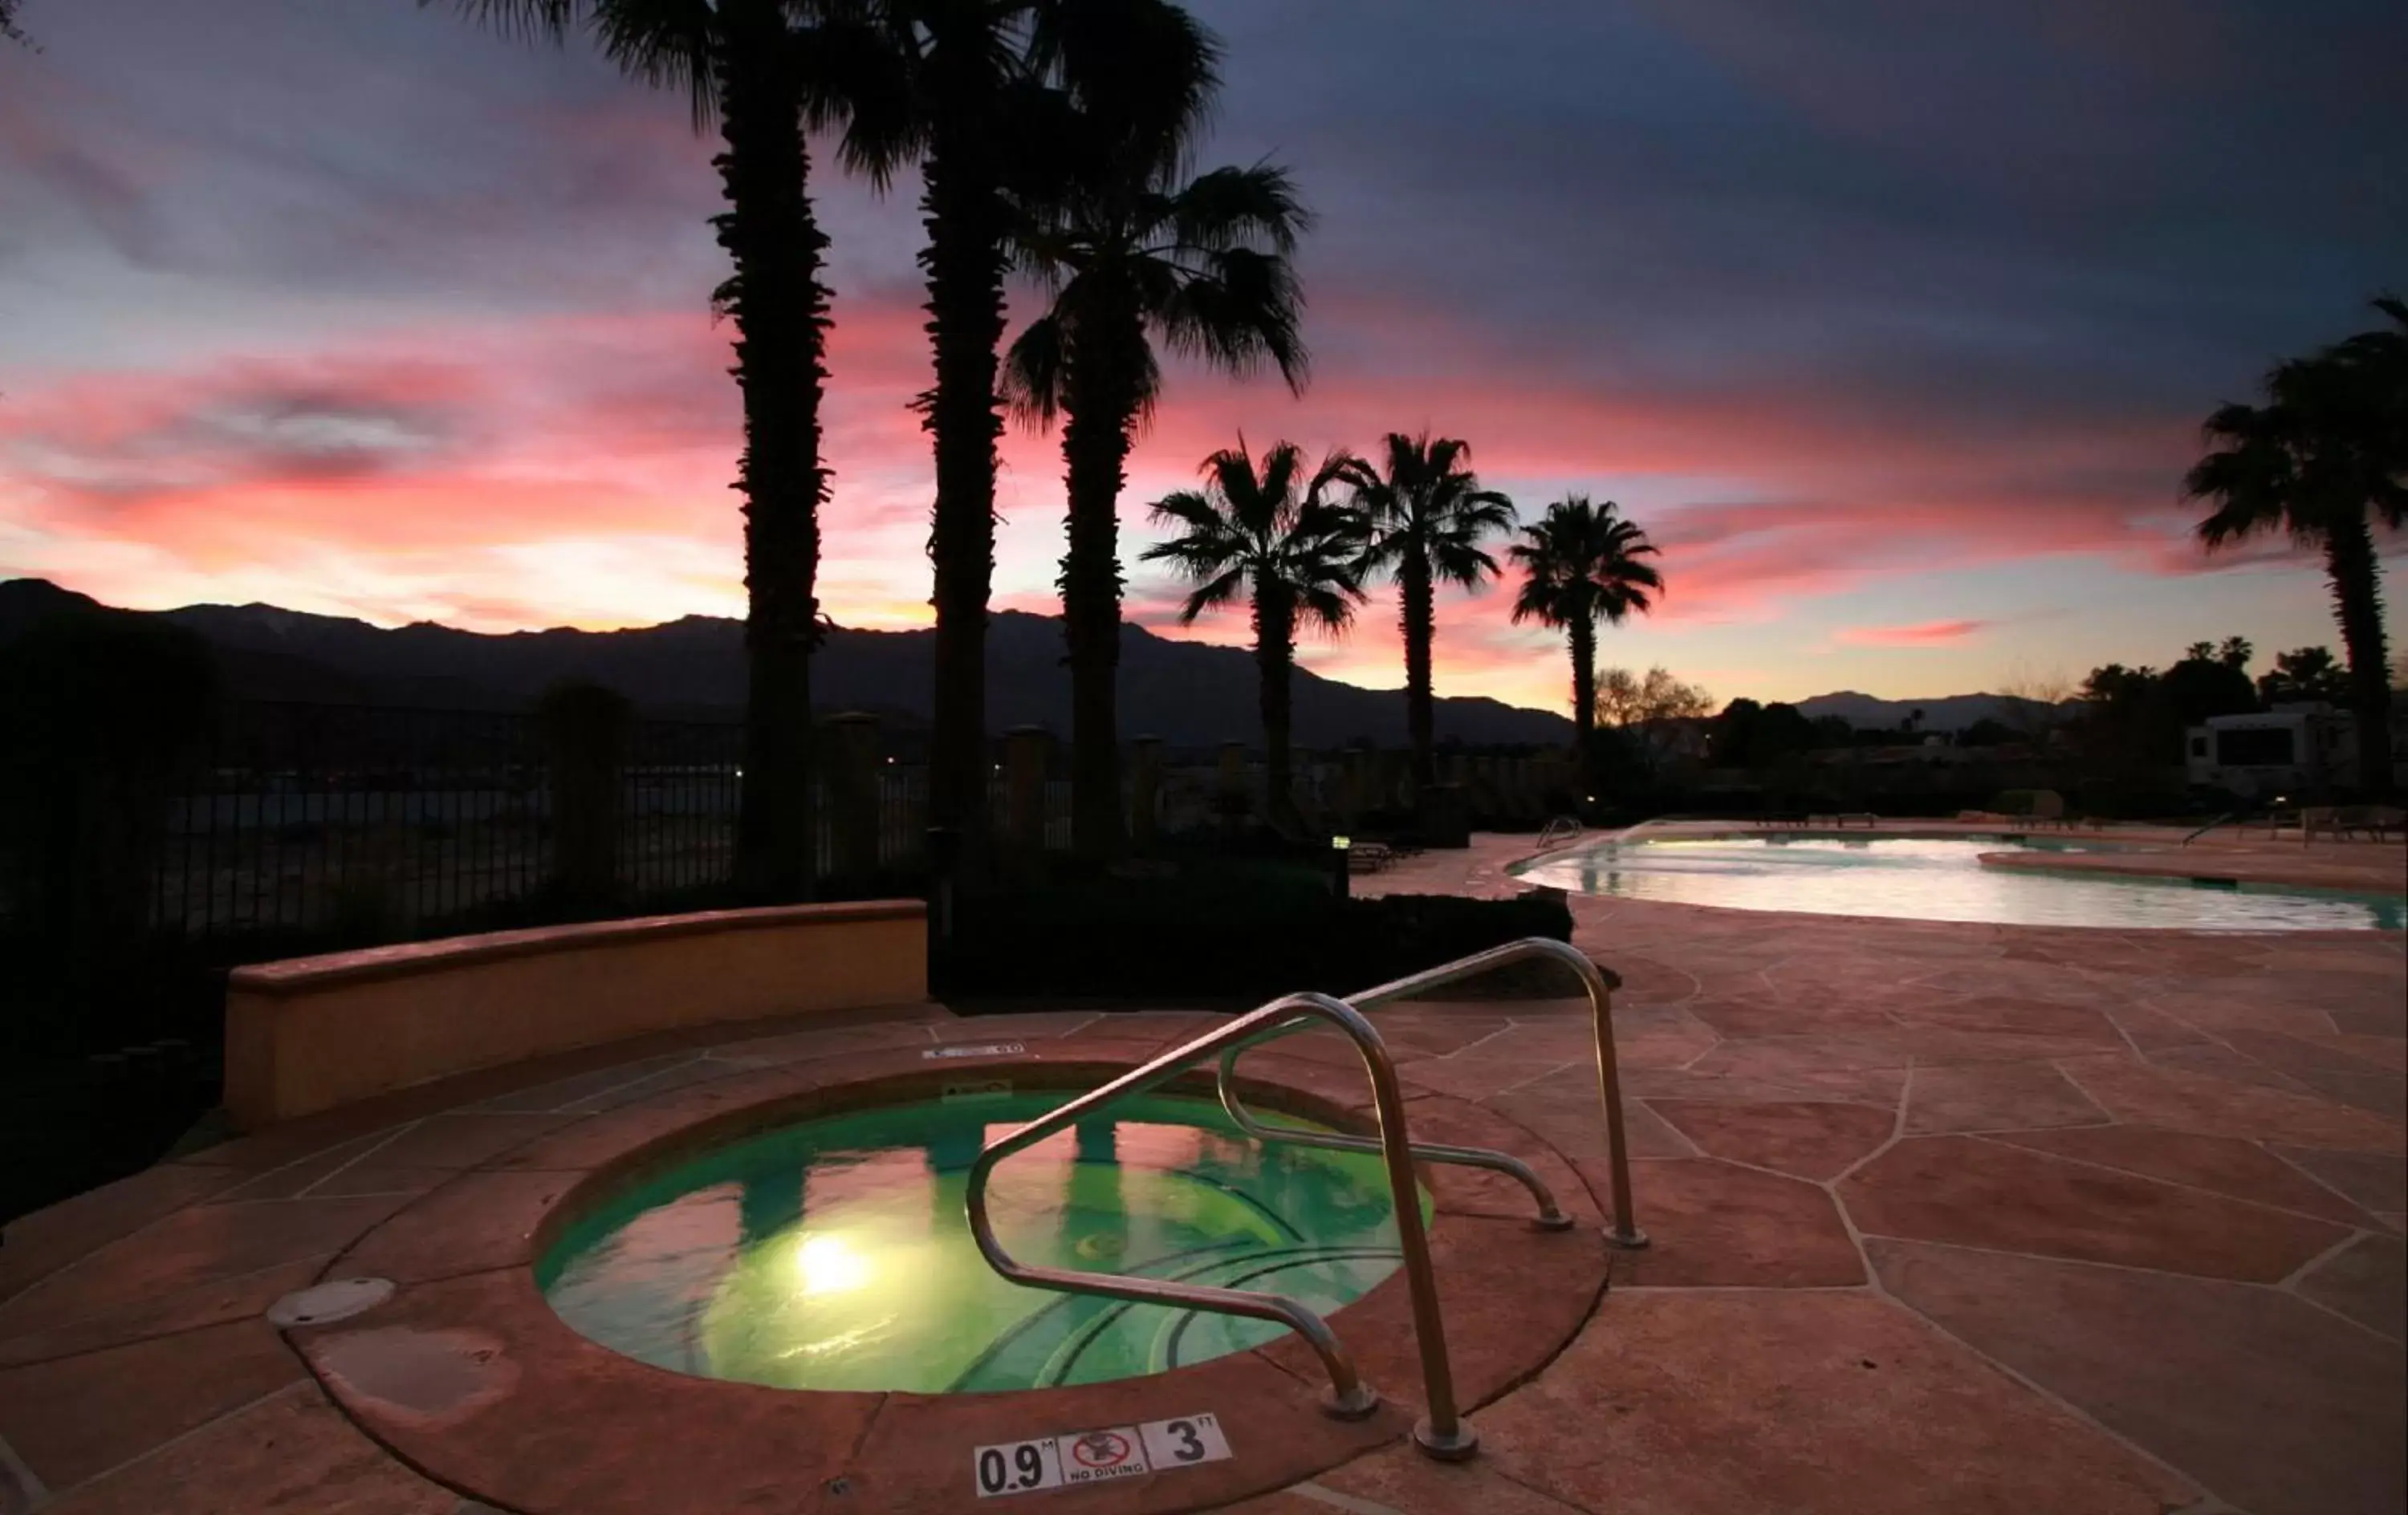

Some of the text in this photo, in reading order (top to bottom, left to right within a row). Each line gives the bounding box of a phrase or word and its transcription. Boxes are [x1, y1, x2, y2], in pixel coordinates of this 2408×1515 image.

[1167, 1420, 1205, 1461] 3
[980, 1444, 1042, 1493] 0.9
[1070, 1464, 1143, 1481] NO DIVING
